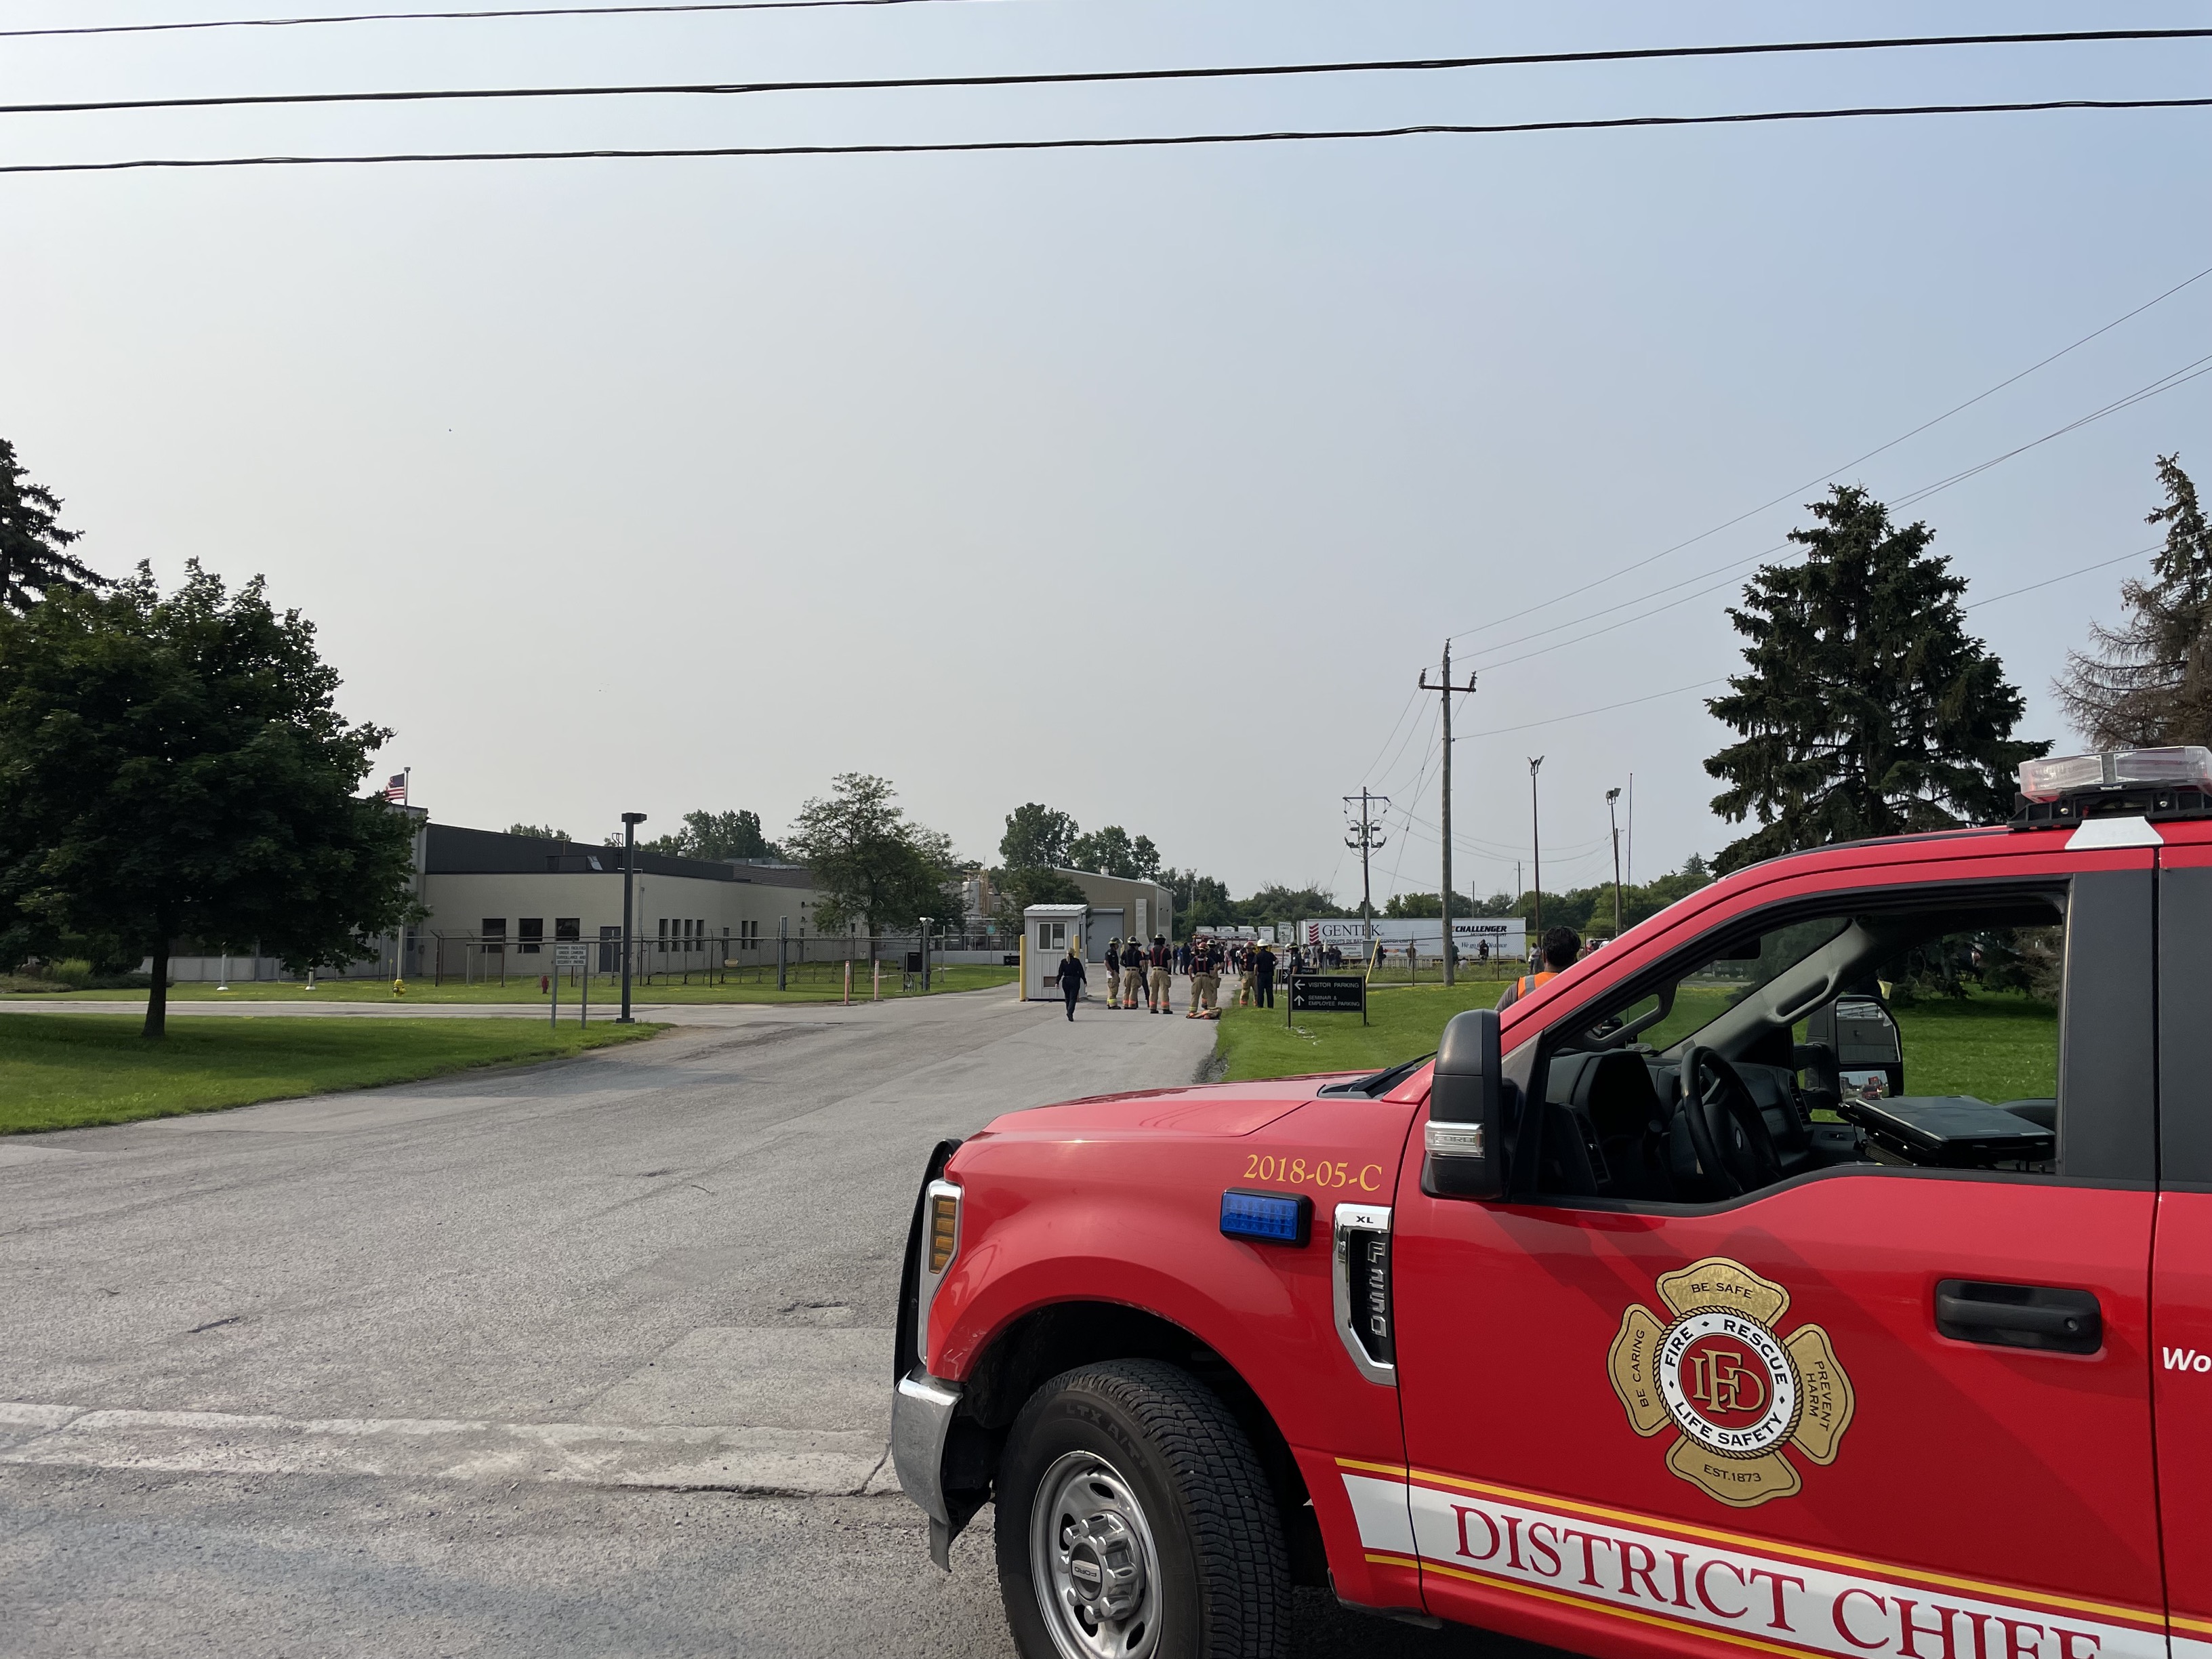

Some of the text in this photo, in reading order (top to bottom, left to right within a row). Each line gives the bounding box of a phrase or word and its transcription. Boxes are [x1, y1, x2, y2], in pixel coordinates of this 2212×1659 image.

[1244, 1154, 1382, 1192] 2018-05-C
[1356, 1215, 1374, 1224] XL
[1692, 1282, 1754, 1299] BE SAFE
[1633, 1329, 1650, 1408] BE CARING
[1664, 1318, 1788, 1385] FIRE RESCUE
[2162, 1346, 2212, 1373] Wo
[1805, 1372, 1820, 1417] HARM
[1814, 1360, 1832, 1432] PREVENT
[1674, 1401, 1783, 1447] LIFE SAFETY
[1703, 1464, 1762, 1483] EST.1873
[1074, 1566, 1097, 1577] FORD
[1450, 1504, 2101, 1659] DISTRICT CHIEF
